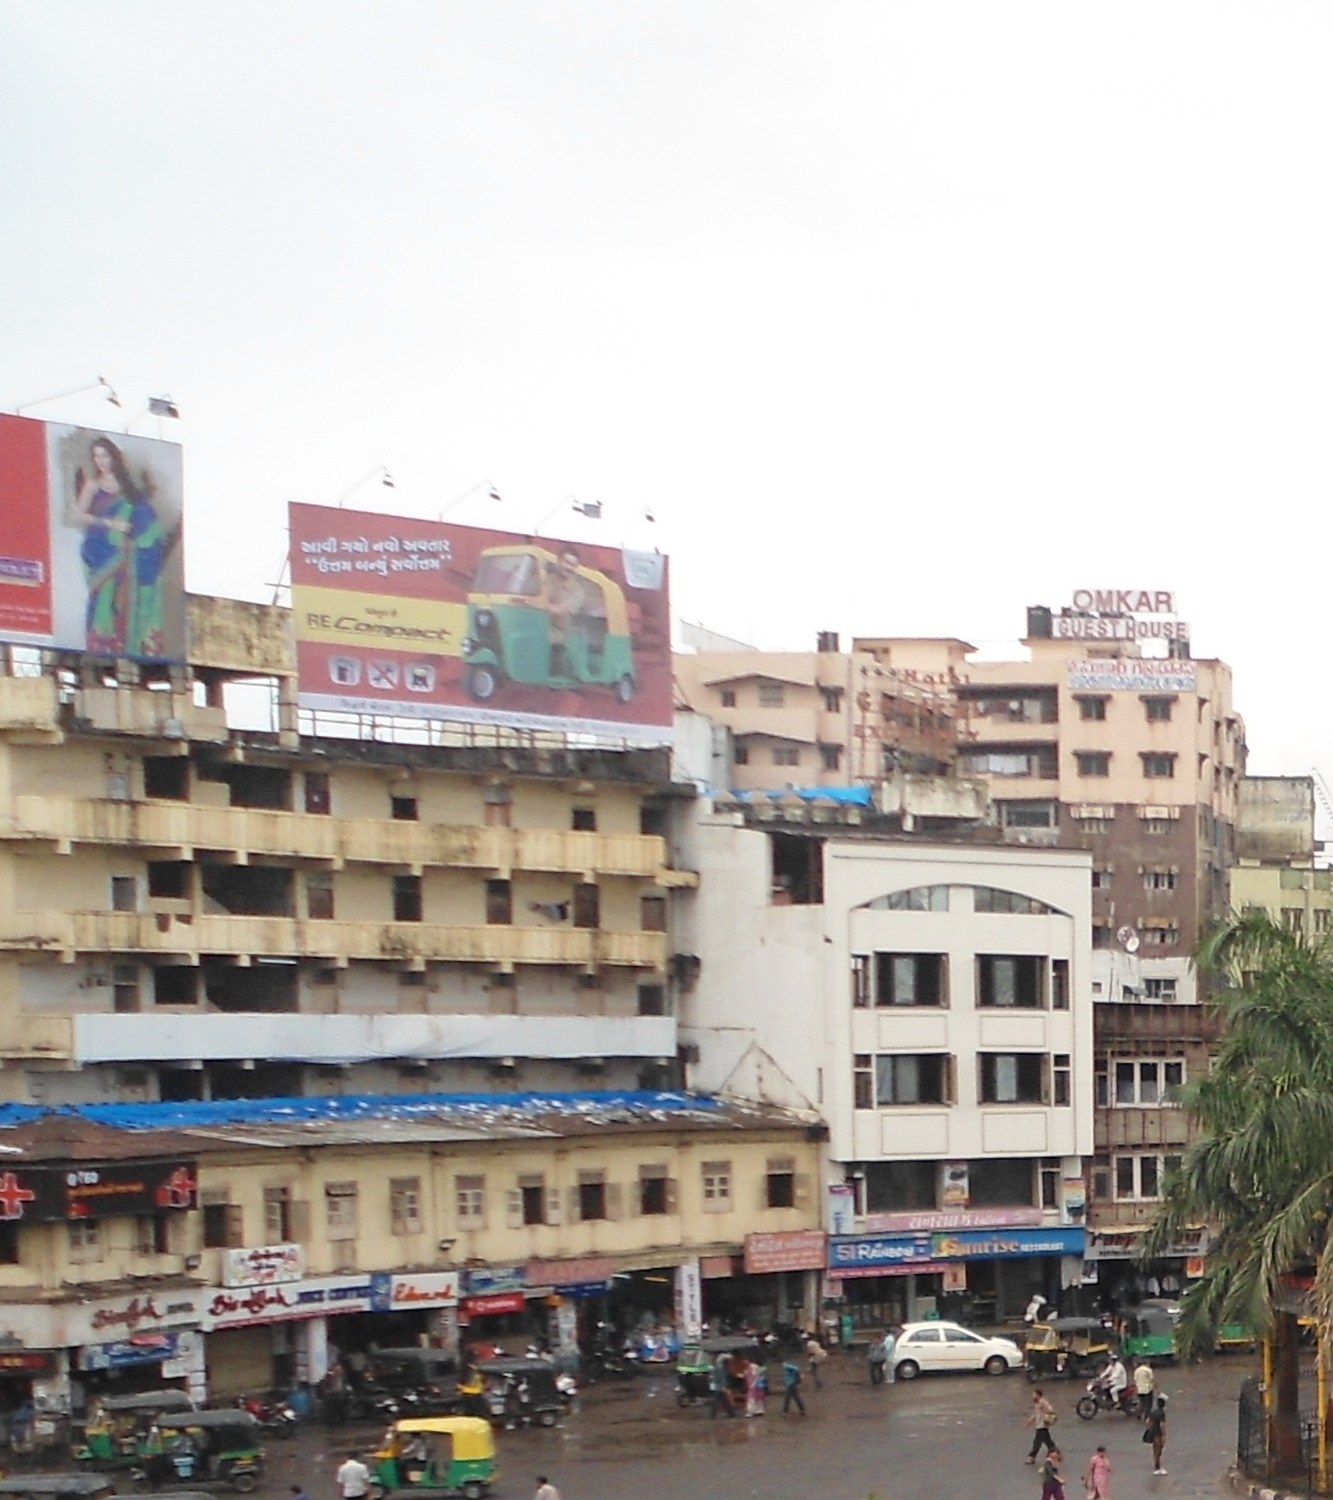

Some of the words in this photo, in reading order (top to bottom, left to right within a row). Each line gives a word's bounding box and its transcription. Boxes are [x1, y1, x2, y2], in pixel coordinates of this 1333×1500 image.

[1072, 589, 1174, 613] OMKAR
[306, 613, 331, 629] RE
[334, 617, 452, 640] Compact
[1058, 619, 1120, 639] GUEST
[1125, 619, 1187, 639] HOUSE
